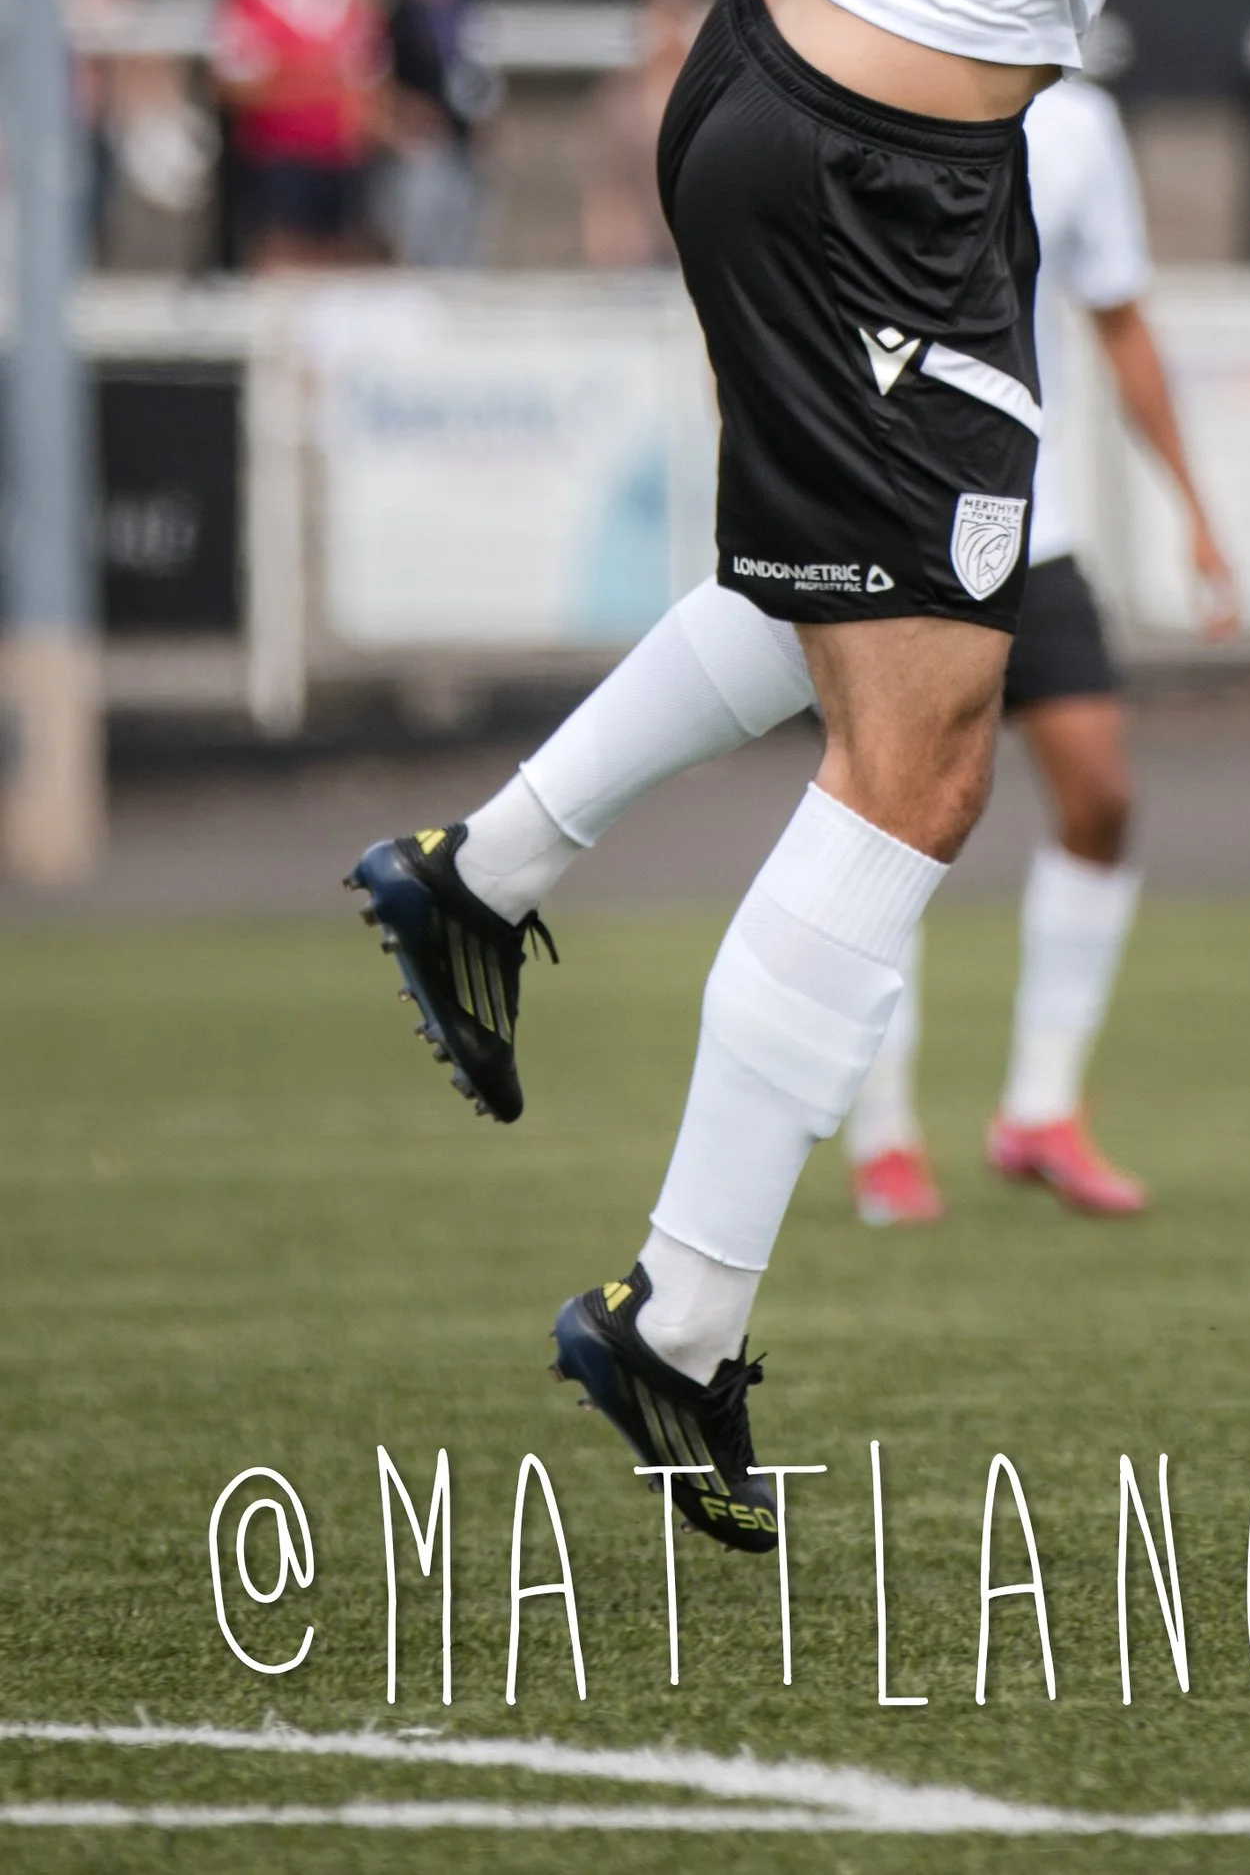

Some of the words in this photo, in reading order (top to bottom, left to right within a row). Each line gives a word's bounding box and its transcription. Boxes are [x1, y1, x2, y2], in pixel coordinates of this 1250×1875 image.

[963, 498, 1020, 514] MERTHYR
[970, 511, 998, 522] TOWN
[733, 555, 862, 582] LONDONMETRIC
[794, 581, 842, 592] PROPERTY
[843, 582, 862, 592] PLC
[700, 1495, 778, 1534] F50
